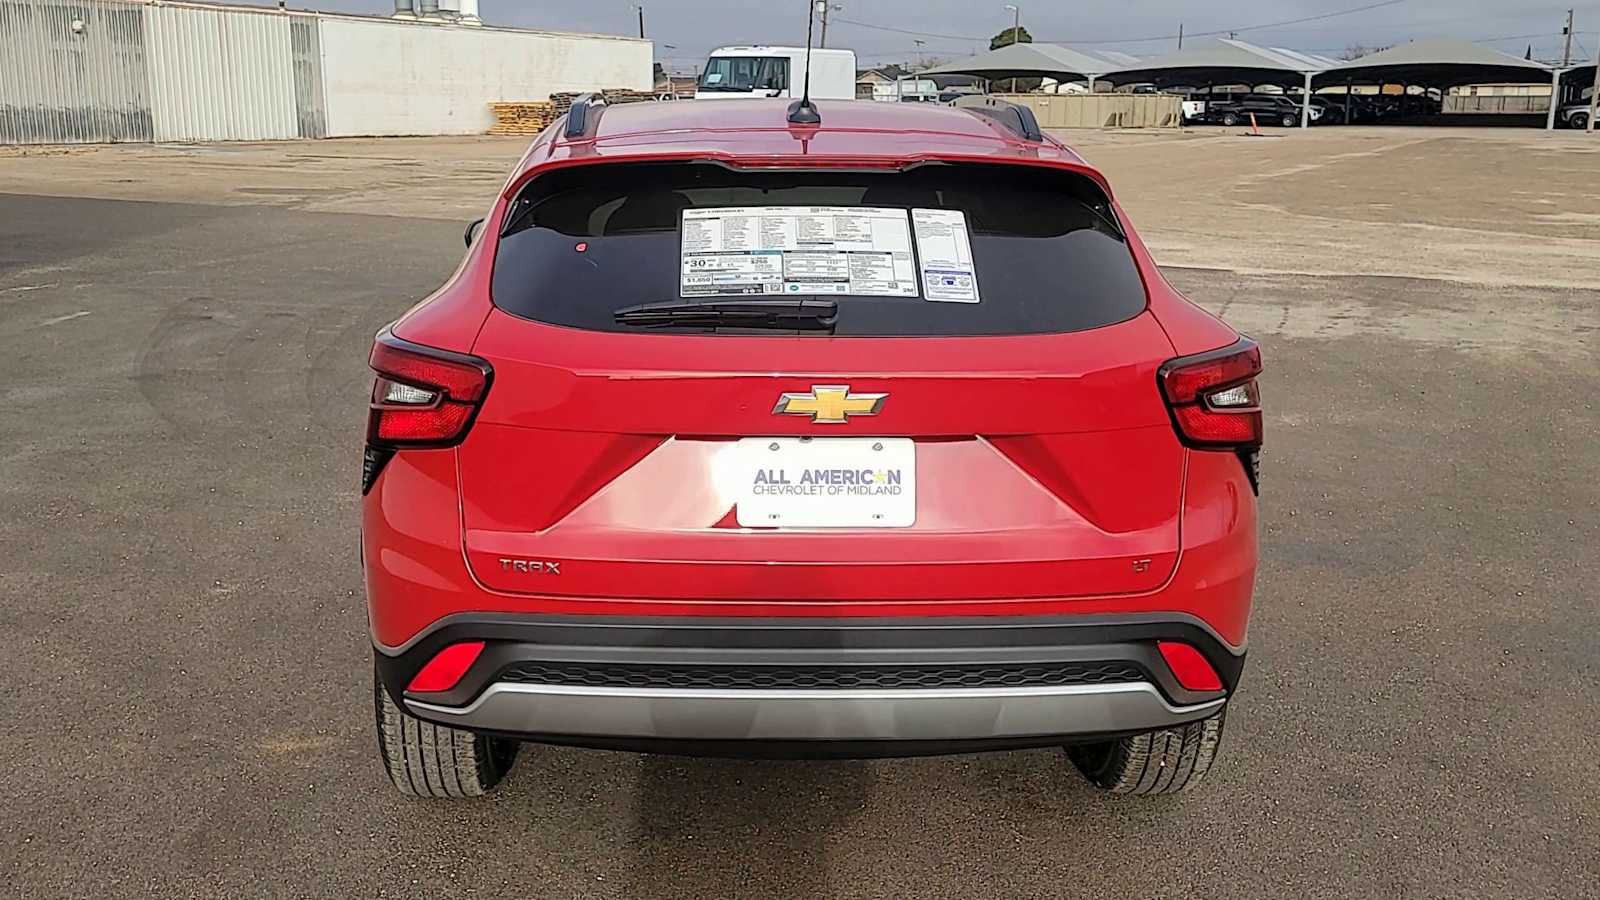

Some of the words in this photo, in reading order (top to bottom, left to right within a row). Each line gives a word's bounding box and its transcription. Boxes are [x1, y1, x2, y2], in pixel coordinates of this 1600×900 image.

[690, 259, 706, 267] 30
[754, 469, 790, 485] ALL
[753, 485, 824, 496] CHEVROLET
[828, 485, 844, 496] OF
[847, 485, 902, 496] MIDLAND
[499, 558, 561, 575] TRAX
[1132, 559, 1152, 573] LT
